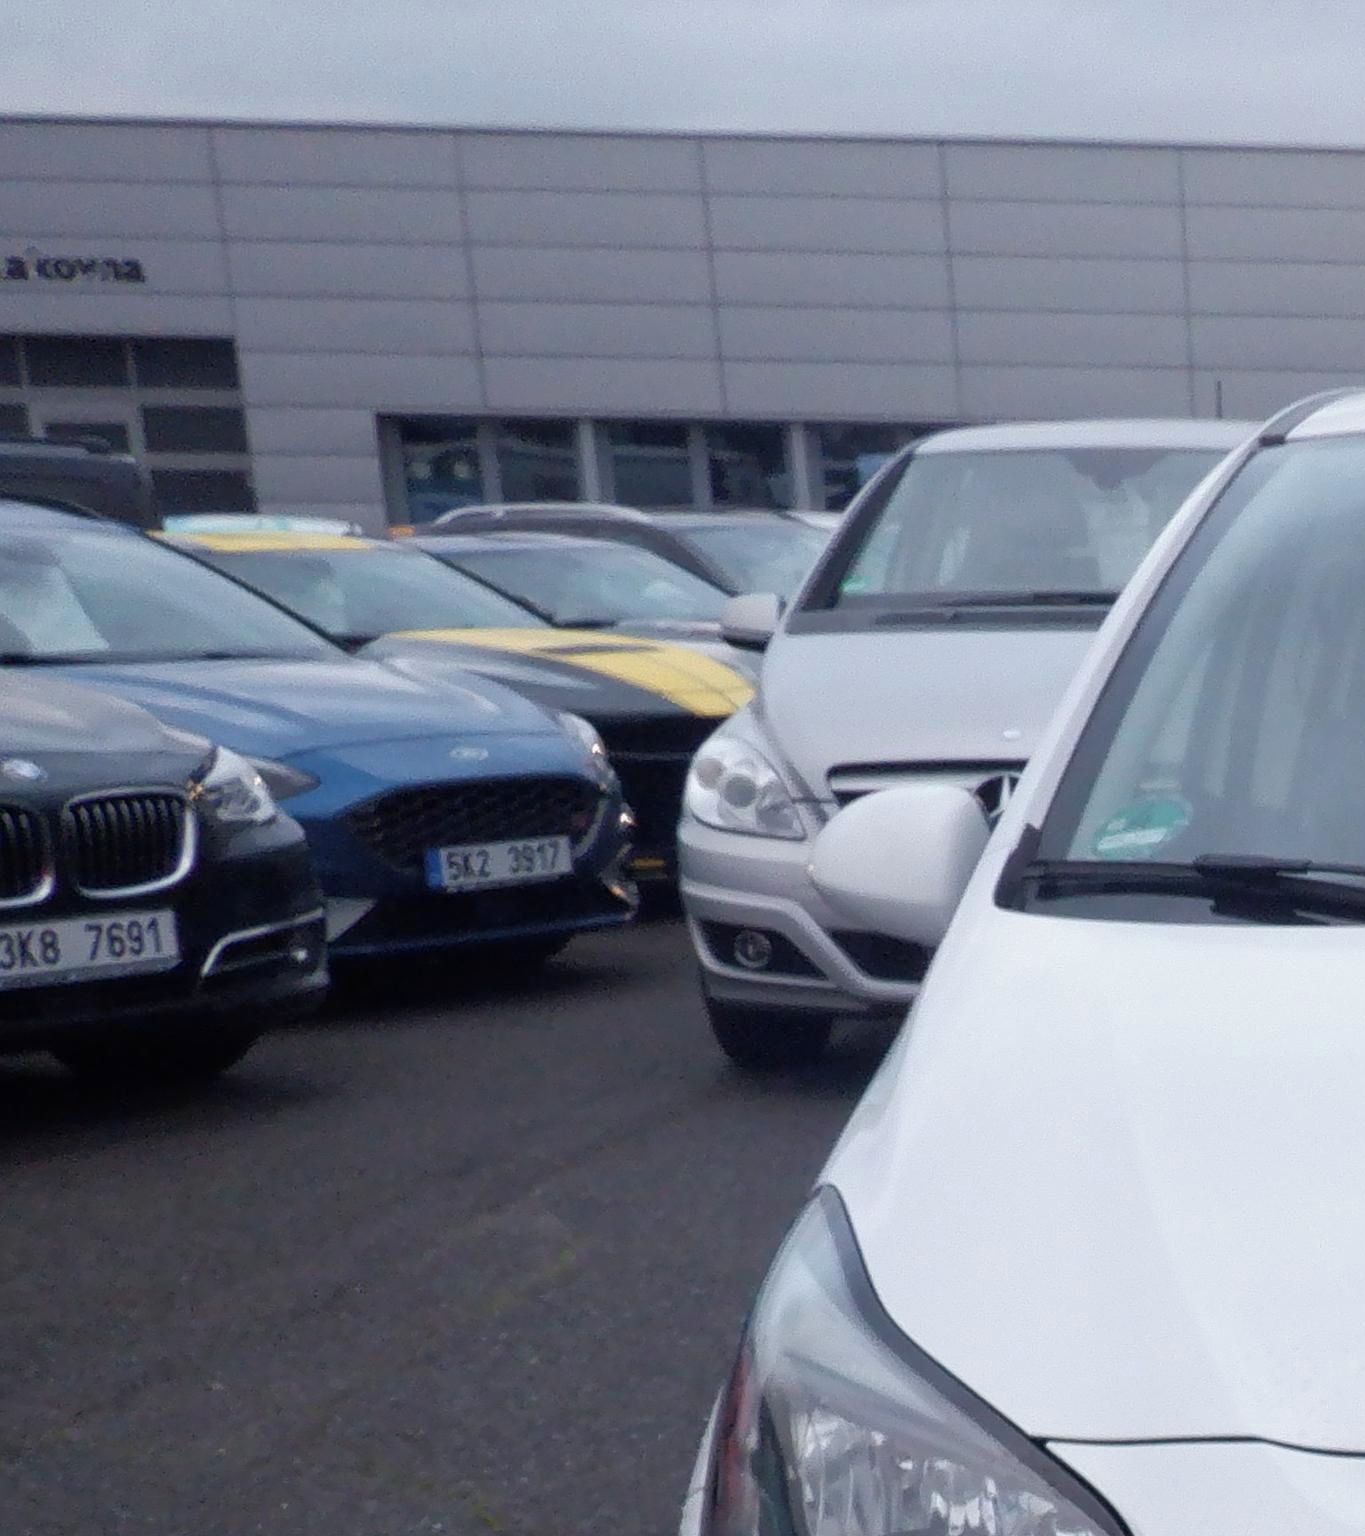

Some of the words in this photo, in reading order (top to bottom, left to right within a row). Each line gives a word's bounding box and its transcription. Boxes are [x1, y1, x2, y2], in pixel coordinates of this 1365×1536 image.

[446, 849, 491, 881] 5K2
[508, 840, 559, 874] 3917
[0, 928, 61, 970] 3K8
[85, 917, 163, 961] 7691
